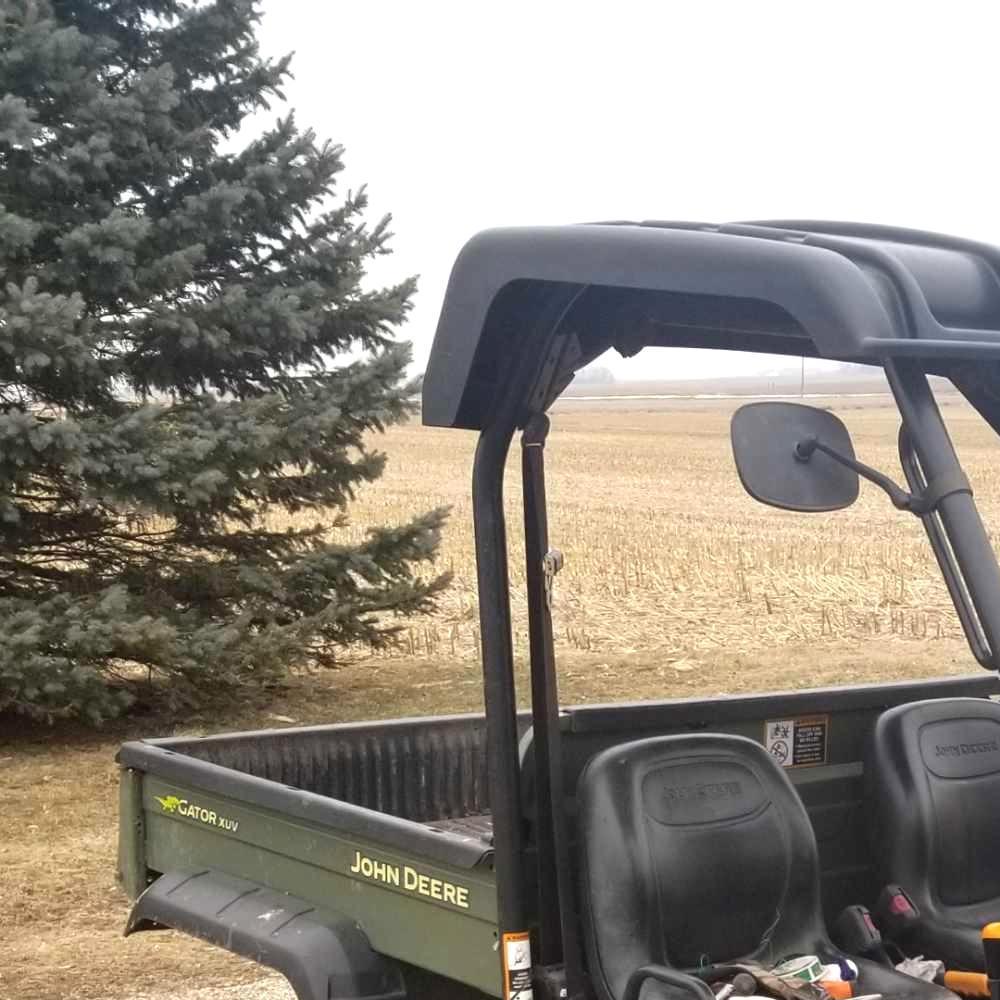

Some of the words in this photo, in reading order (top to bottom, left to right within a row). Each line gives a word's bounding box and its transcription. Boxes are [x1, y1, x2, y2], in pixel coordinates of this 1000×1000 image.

[177, 799, 217, 826] GATOR
[218, 816, 239, 832] XUV
[350, 851, 400, 886] JOHN
[403, 865, 469, 909] DEERE
